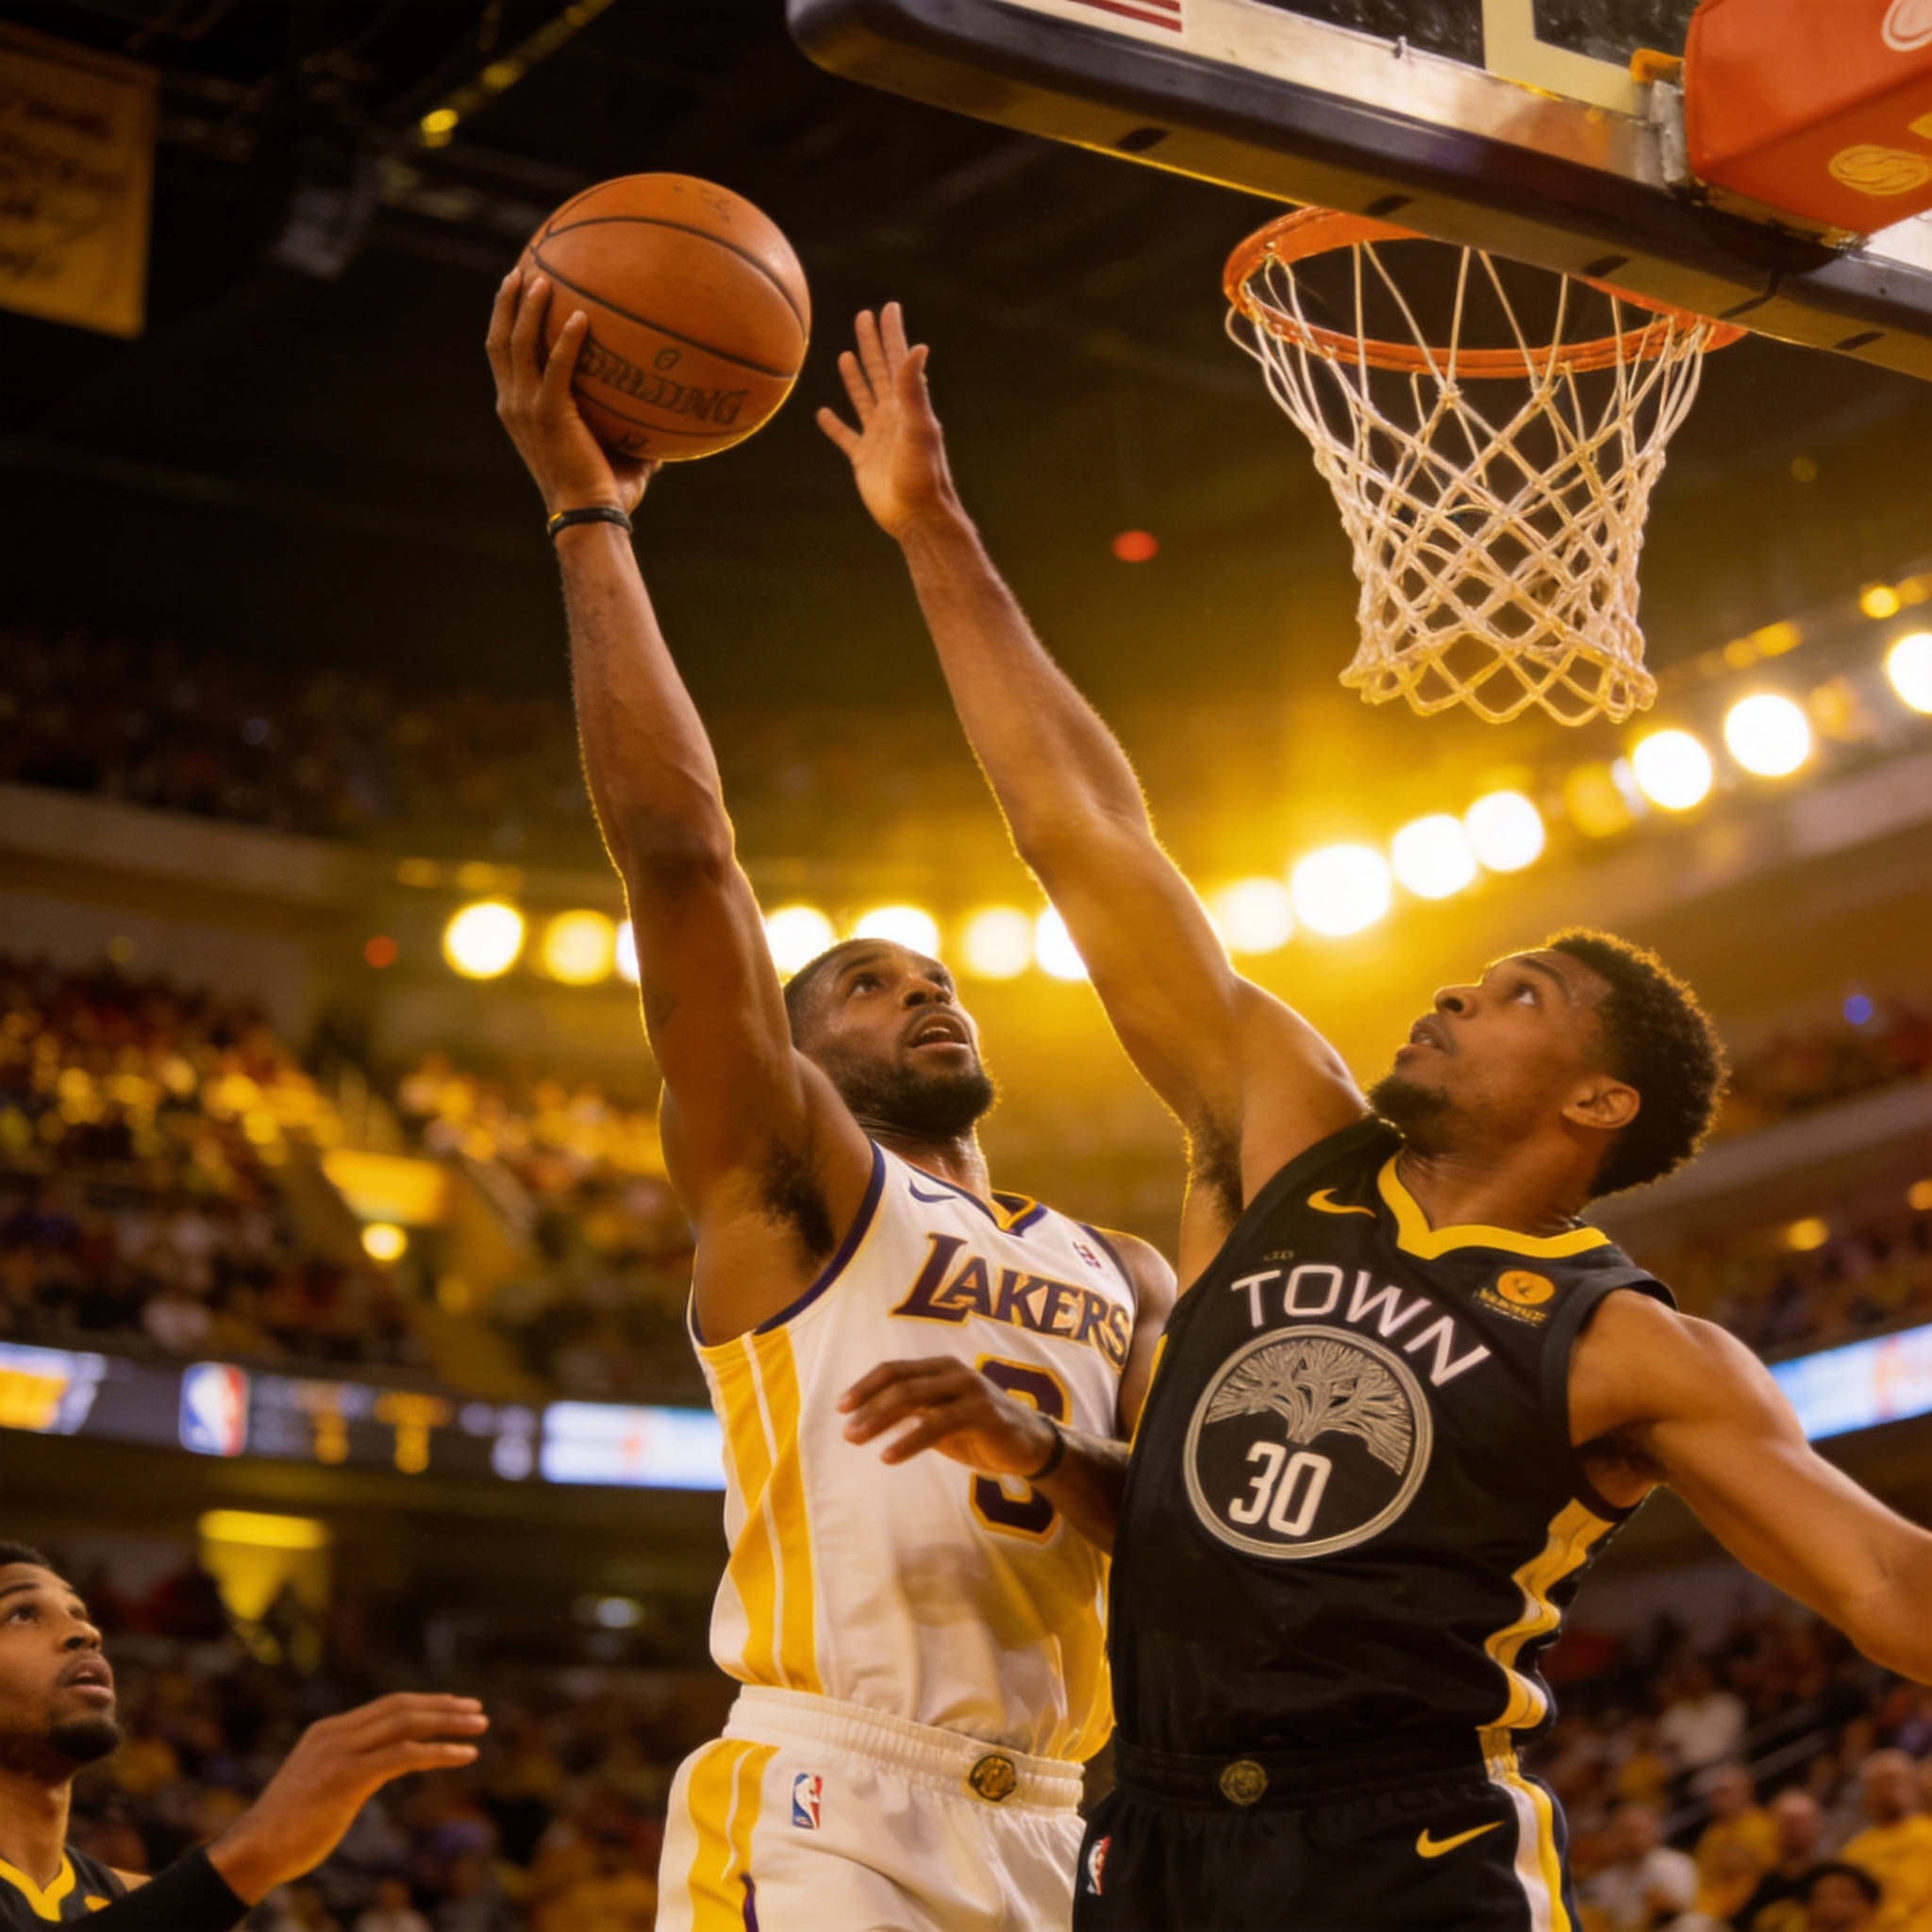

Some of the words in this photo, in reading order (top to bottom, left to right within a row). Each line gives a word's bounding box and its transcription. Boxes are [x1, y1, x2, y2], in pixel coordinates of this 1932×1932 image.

[889, 1232, 1132, 1374] LAKERS
[1231, 1264, 1491, 1388] TOWN
[1228, 1441, 1332, 1537] 30
